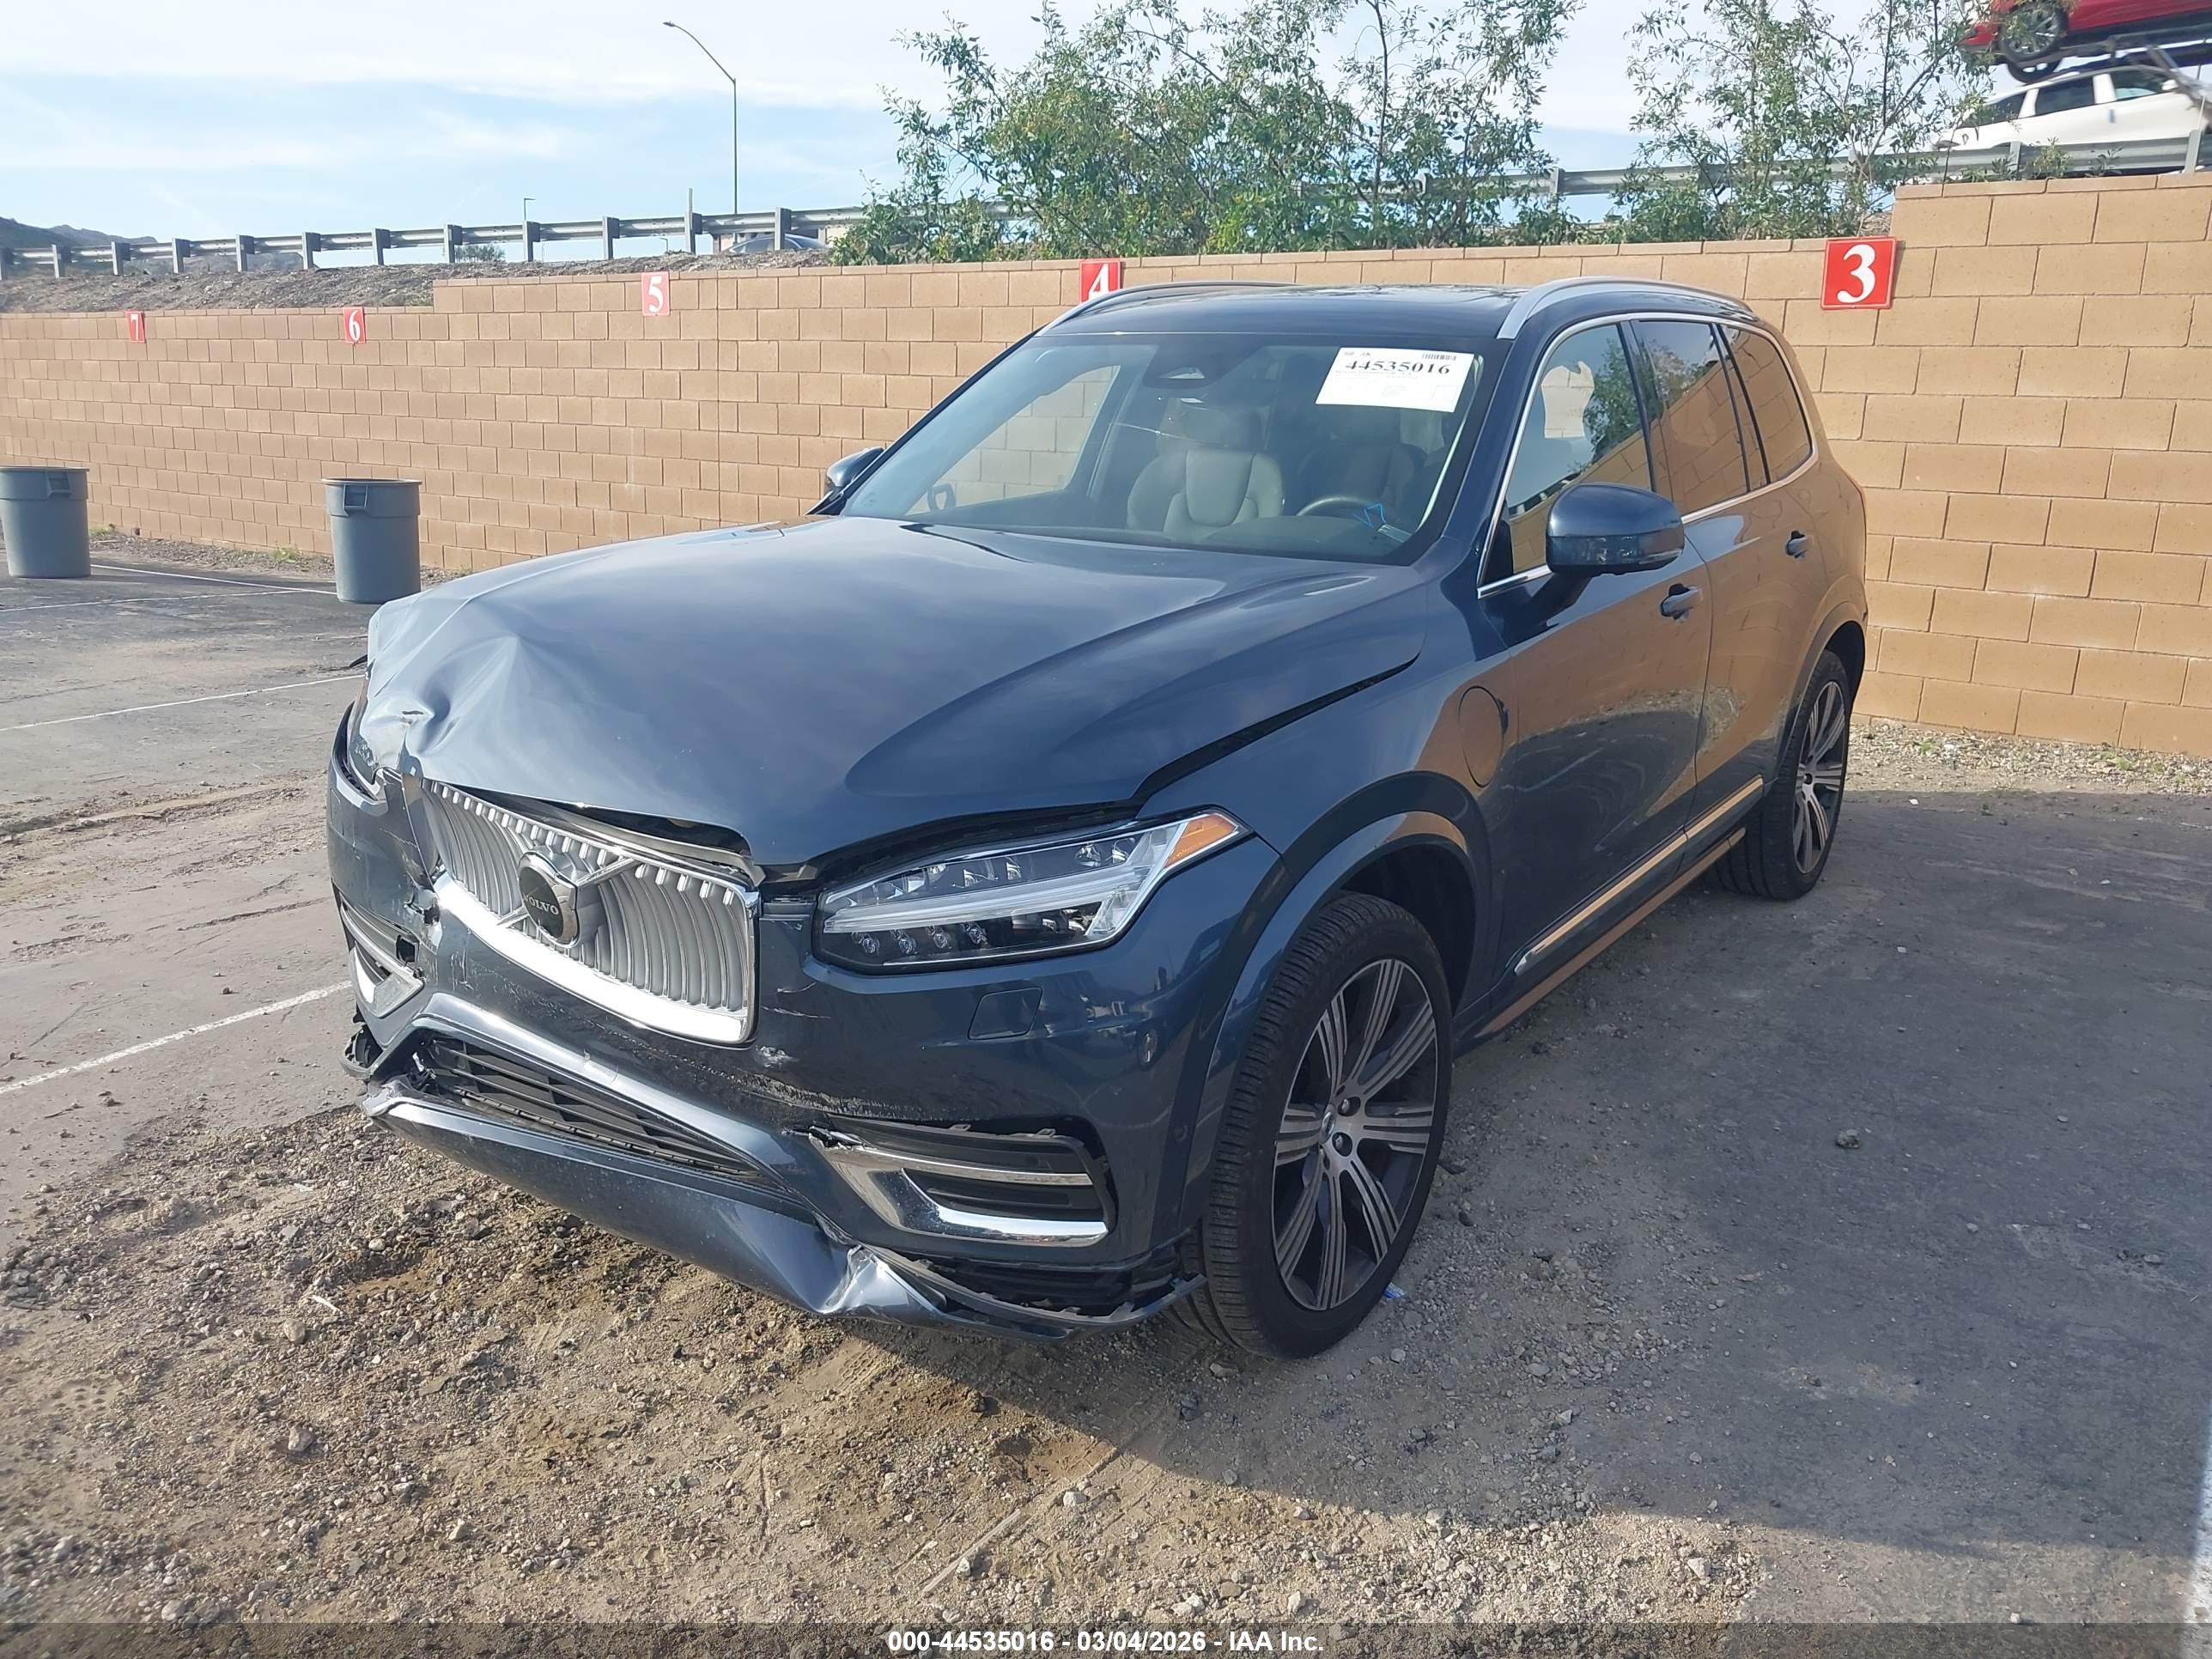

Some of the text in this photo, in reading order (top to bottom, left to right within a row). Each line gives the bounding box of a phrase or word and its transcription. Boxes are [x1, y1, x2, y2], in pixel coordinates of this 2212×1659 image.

[1088, 263, 1109, 301] 4
[1837, 244, 1876, 303] 3
[648, 276, 664, 313] 5
[130, 313, 139, 340] 7
[349, 309, 361, 341] 6
[1345, 360, 1451, 375] 44535016
[523, 892, 559, 915] VOLVO
